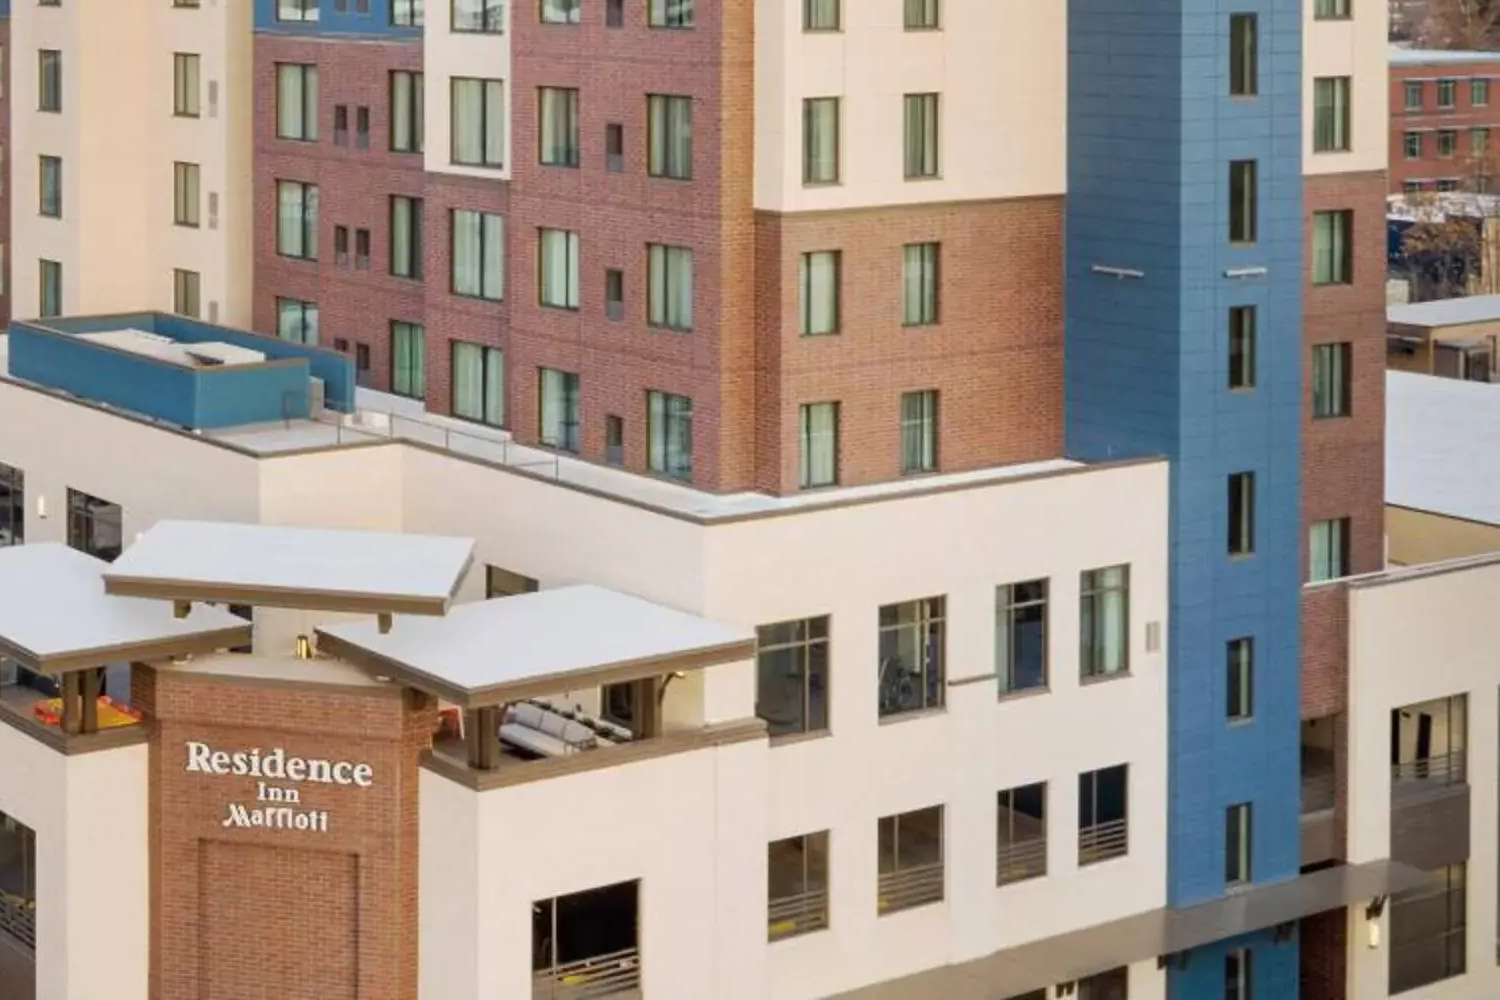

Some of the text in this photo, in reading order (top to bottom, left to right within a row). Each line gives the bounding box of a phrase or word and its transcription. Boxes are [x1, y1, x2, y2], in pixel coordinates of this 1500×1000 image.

[185, 741, 374, 787] Residence
[257, 781, 300, 803] Inn
[222, 803, 330, 833] Marriott
